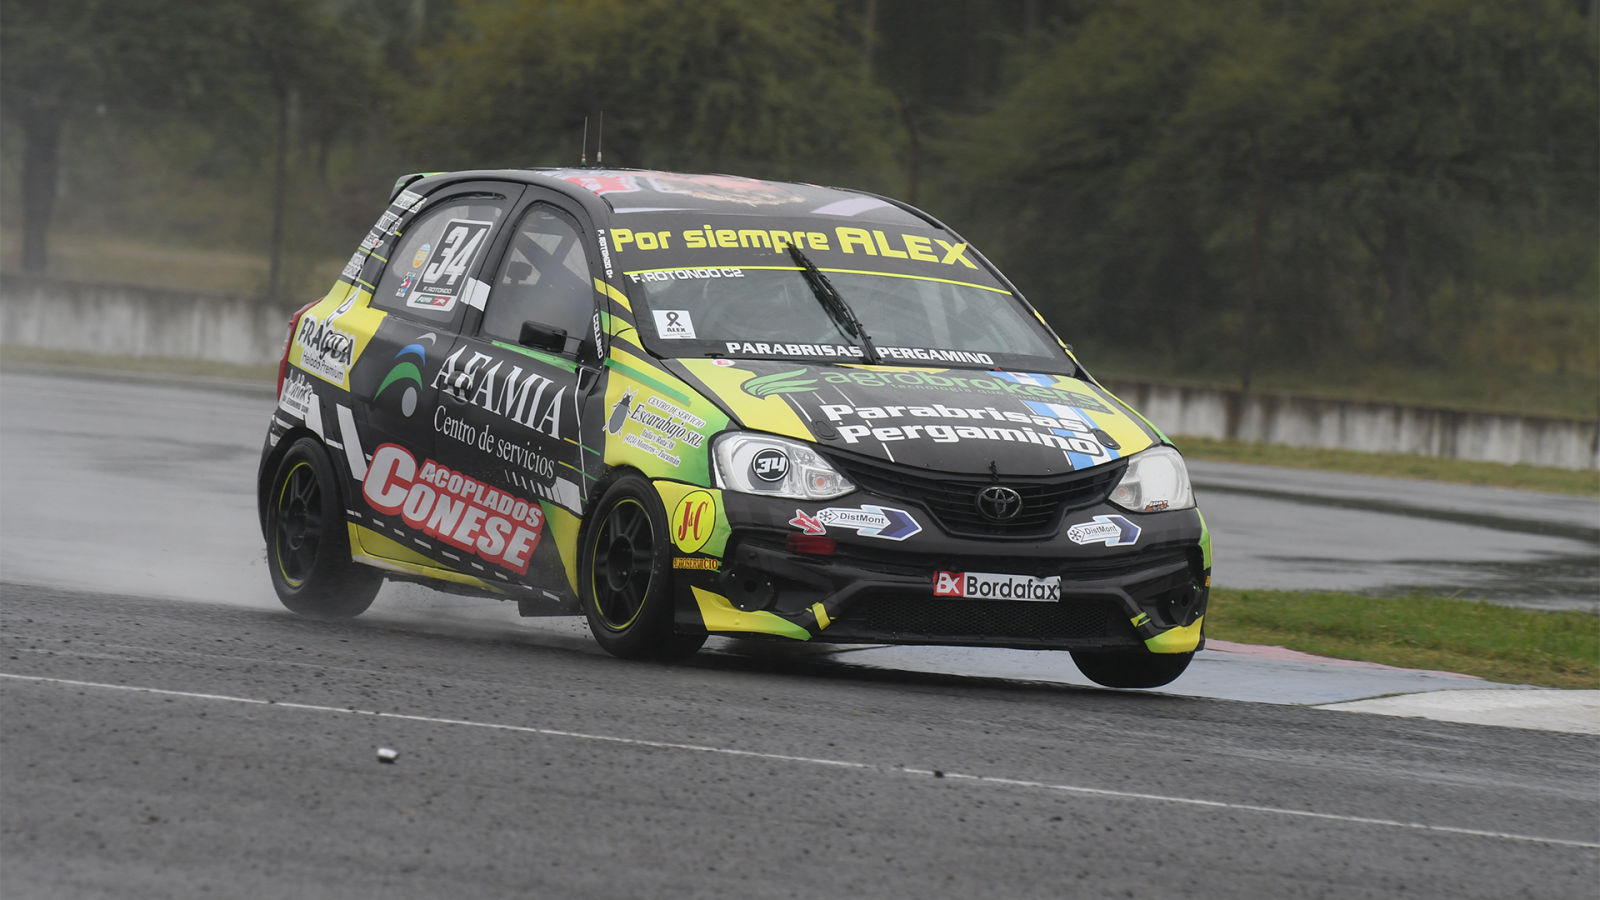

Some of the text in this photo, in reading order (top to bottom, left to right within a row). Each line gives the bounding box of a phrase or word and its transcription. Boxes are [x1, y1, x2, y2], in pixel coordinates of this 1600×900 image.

[423, 226, 487, 285] 34
[610, 225, 979, 270] Por siempre ALEX
[720, 268, 745, 278] C2
[592, 313, 604, 359] COLLINO
[302, 351, 344, 381] Helado Premium
[726, 342, 994, 365] PARABRISAS PERGAMINO
[430, 345, 567, 440] AFAMIA
[819, 371, 1100, 406] agrobrokers
[630, 404, 704, 448] Escarabajo SRL
[648, 396, 706, 428] CENTRO DE SERVICIO
[820, 404, 1091, 433] Parabrisas
[434, 405, 555, 479] Centro de servicios
[836, 425, 1102, 456] Pergamino
[756, 457, 786, 473] 34
[364, 446, 537, 568] CONESE
[419, 462, 542, 527] ACOPLADOS
[678, 501, 709, 541] J&C
[840, 512, 884, 524] DistMont
[1084, 525, 1118, 535] DistMont
[673, 558, 718, 569] AUTOSERVICIO
[966, 576, 1058, 599] Bordafax
